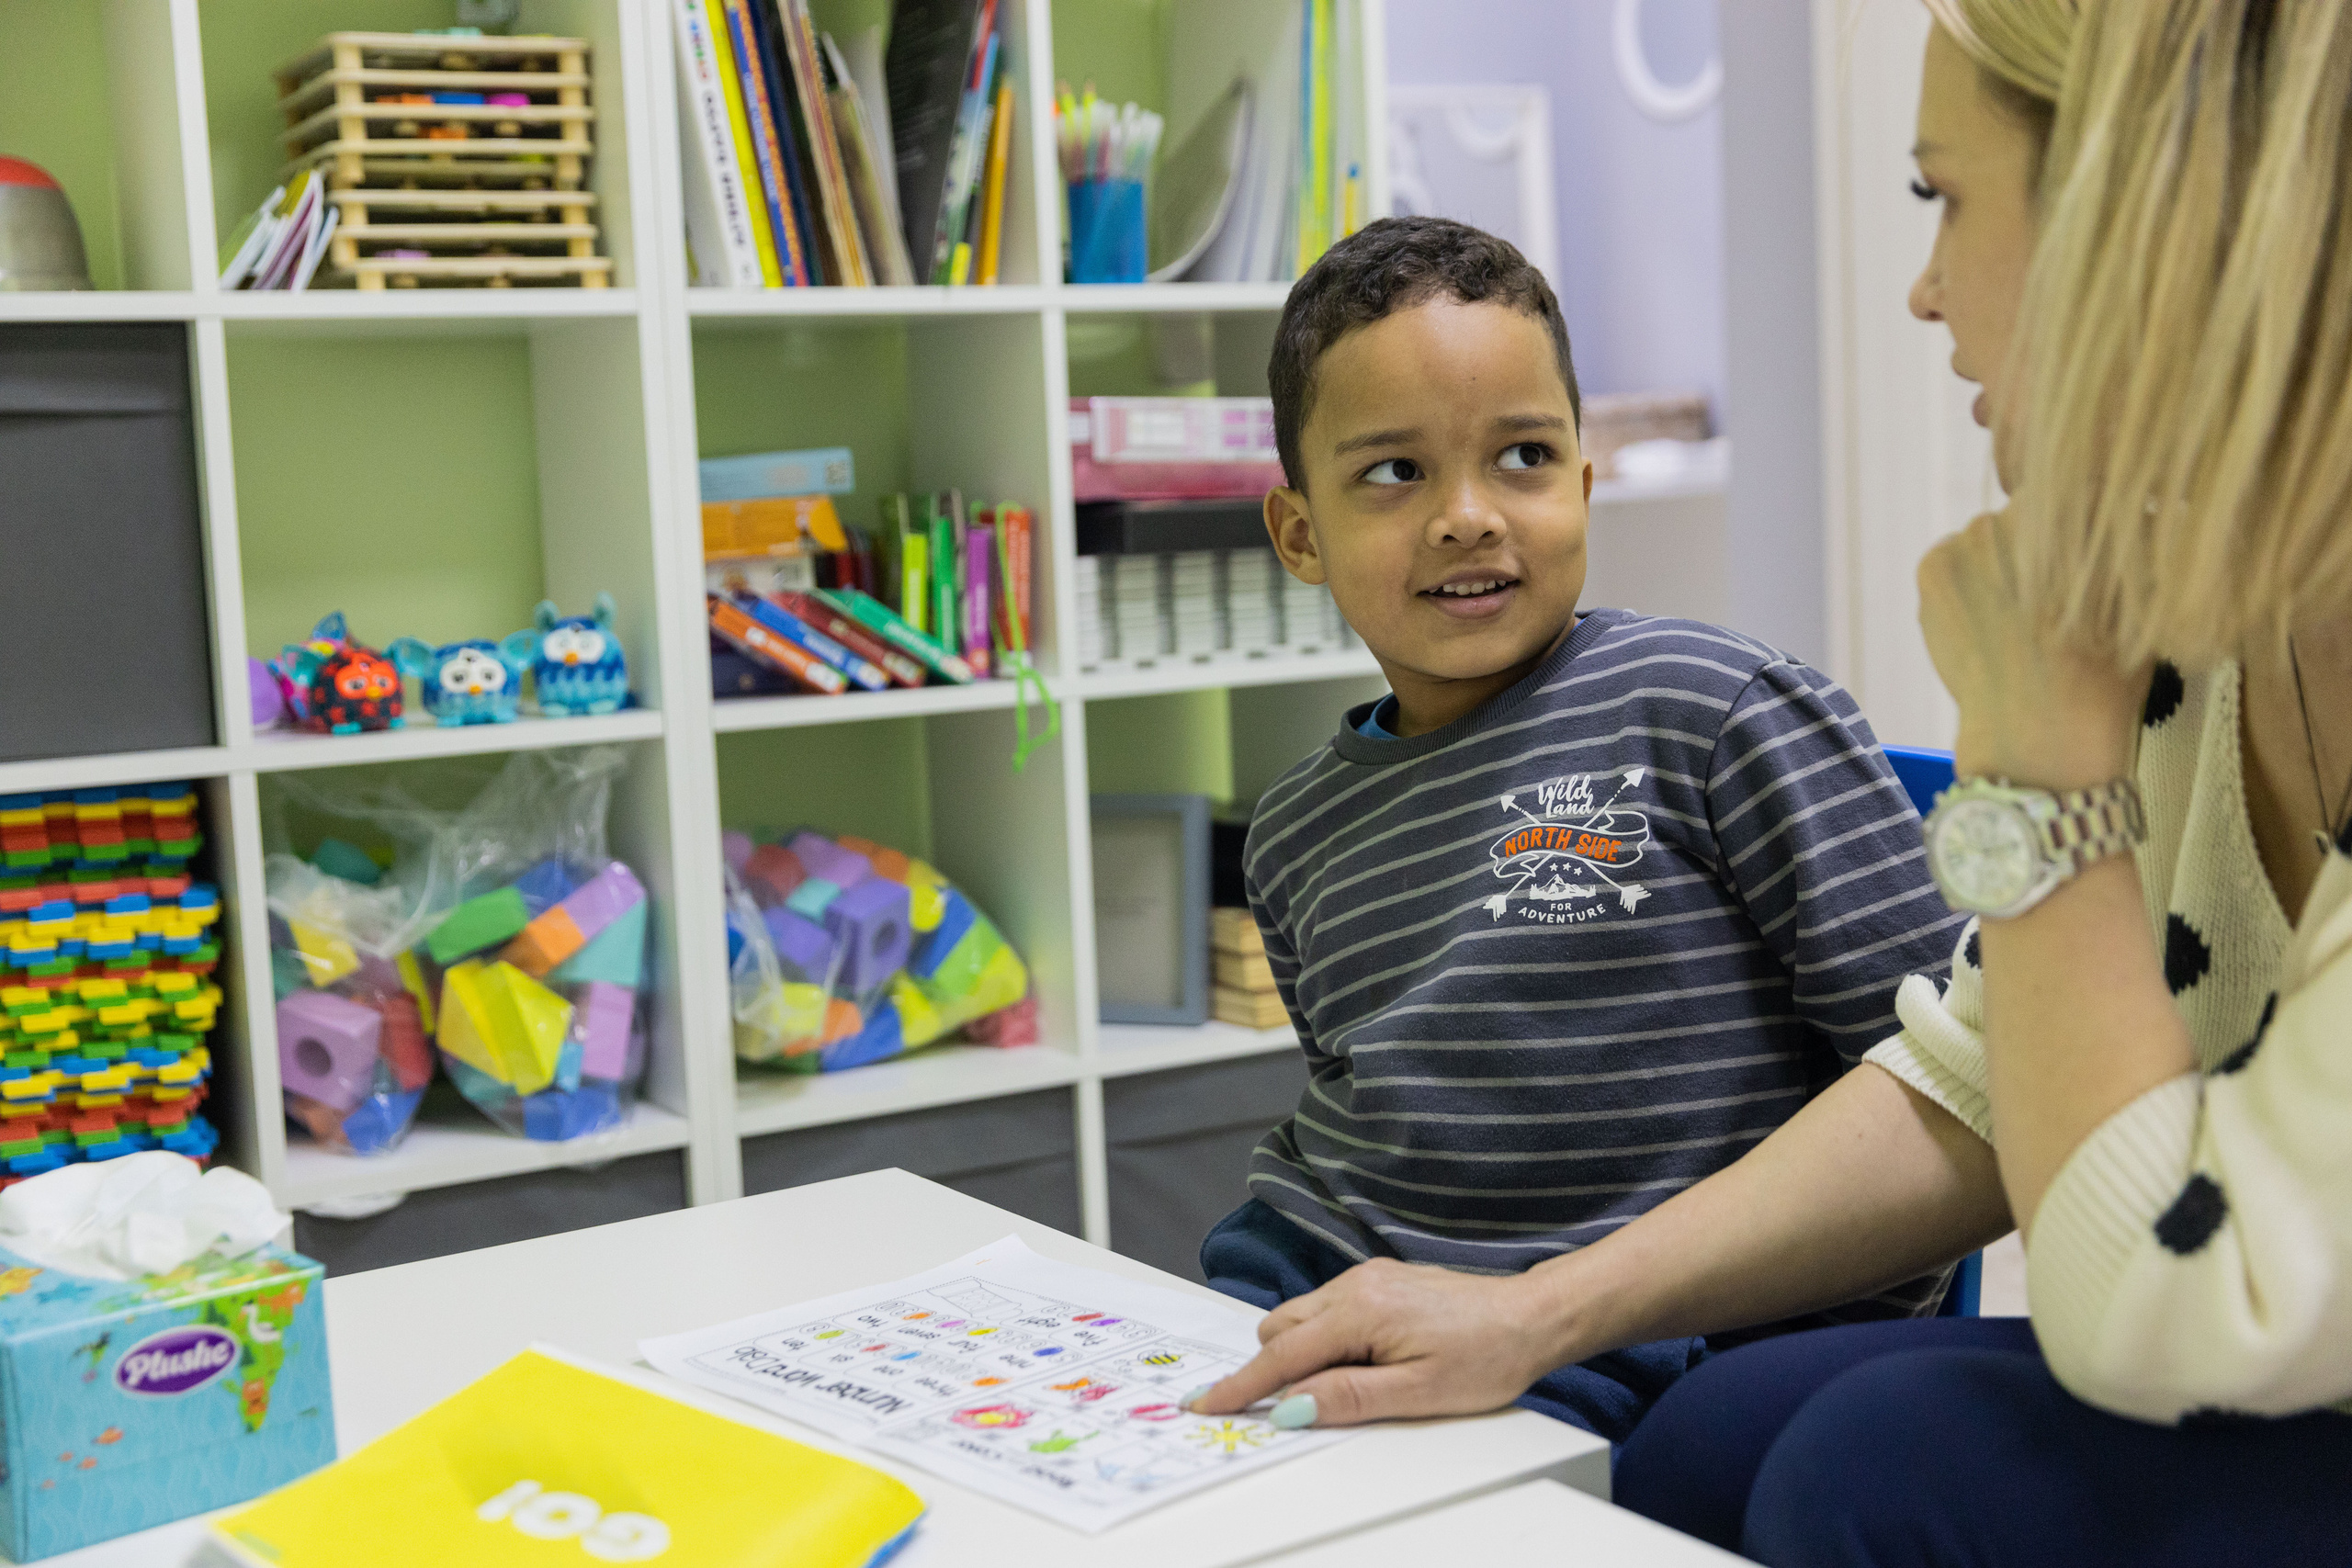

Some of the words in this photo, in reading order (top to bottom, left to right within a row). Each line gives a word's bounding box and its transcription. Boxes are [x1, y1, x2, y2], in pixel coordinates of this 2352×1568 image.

[1538, 774, 1592, 806] Wild
[1545, 794, 1595, 819] Land
[1505, 827, 1572, 858] NORTH
[1575, 833, 1623, 862] SIDE
[1518, 903, 1607, 924] ADVENTURE
[1550, 902, 1572, 911] FOR
[856, 1314, 888, 1329] two
[781, 1337, 810, 1352] ten
[1073, 1331, 1109, 1347] five
[126, 1340, 230, 1386] Plushe
[726, 1346, 781, 1371] Dab
[752, 1364, 825, 1388] Word
[814, 1380, 914, 1415] Number
